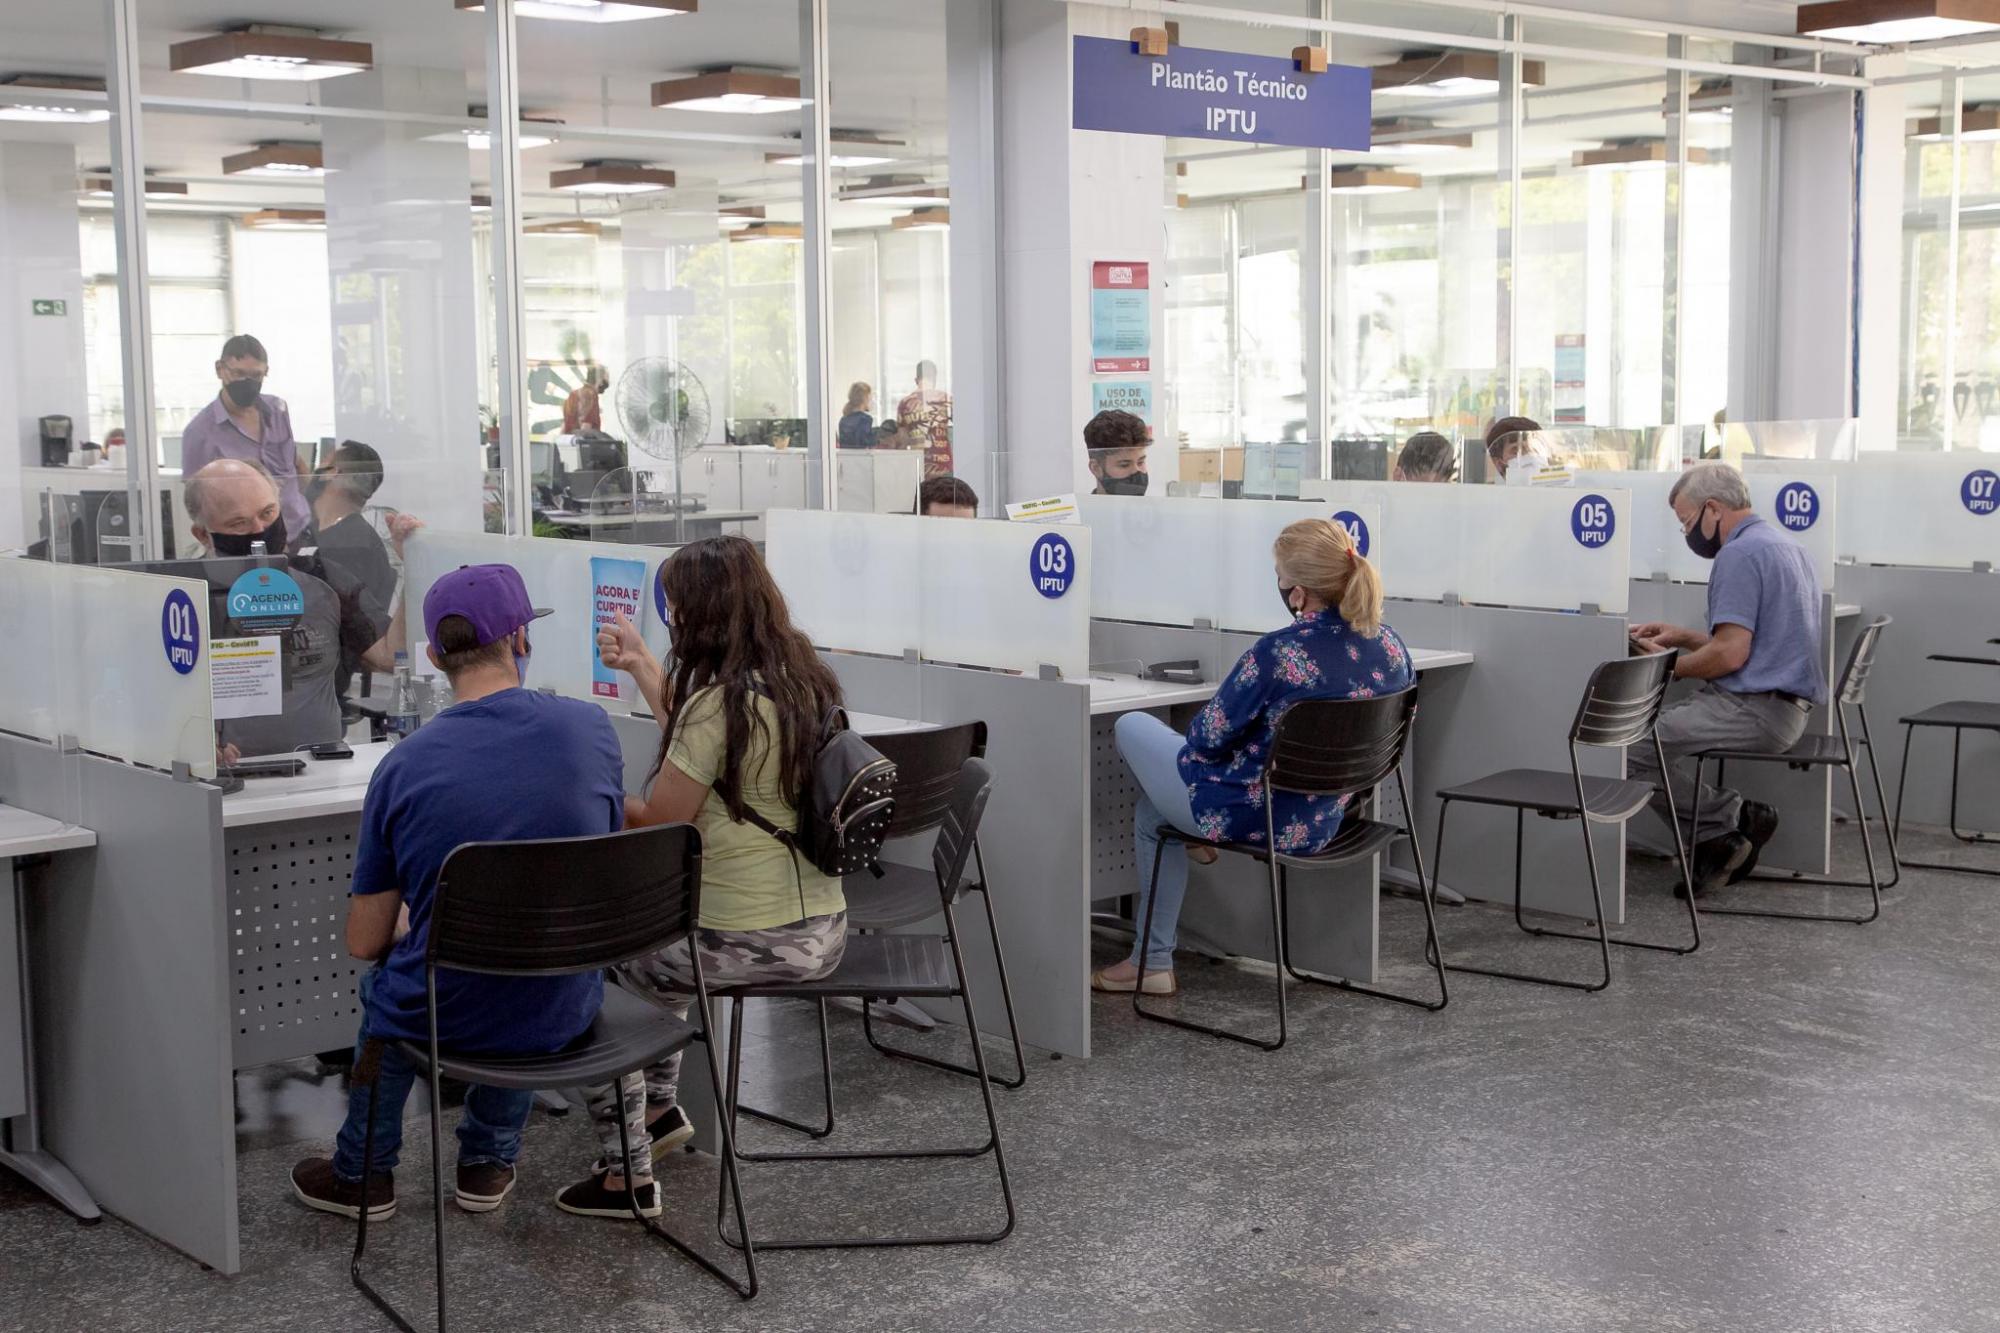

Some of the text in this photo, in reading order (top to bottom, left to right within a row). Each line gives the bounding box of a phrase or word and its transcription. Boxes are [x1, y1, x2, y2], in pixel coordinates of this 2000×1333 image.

[1151, 62, 1308, 101] Plantão Técnico
[1206, 106, 1257, 134] IPTU
[1106, 388, 1142, 398] USO DE
[1970, 476, 1996, 497] 07
[1784, 489, 1812, 513] 06
[1970, 500, 1994, 511] IPTU
[1580, 503, 1608, 528] 05
[1785, 514, 1810, 526] IPTU
[1581, 531, 1606, 543] IPTU
[1039, 543, 1067, 573] 03
[595, 584, 641, 600] AGORA E
[1040, 577, 1065, 591] IPTU
[250, 593, 299, 603] AGENDA
[250, 602, 300, 612] ONLINE
[168, 601, 193, 642] 01
[171, 646, 193, 666] IPTU
